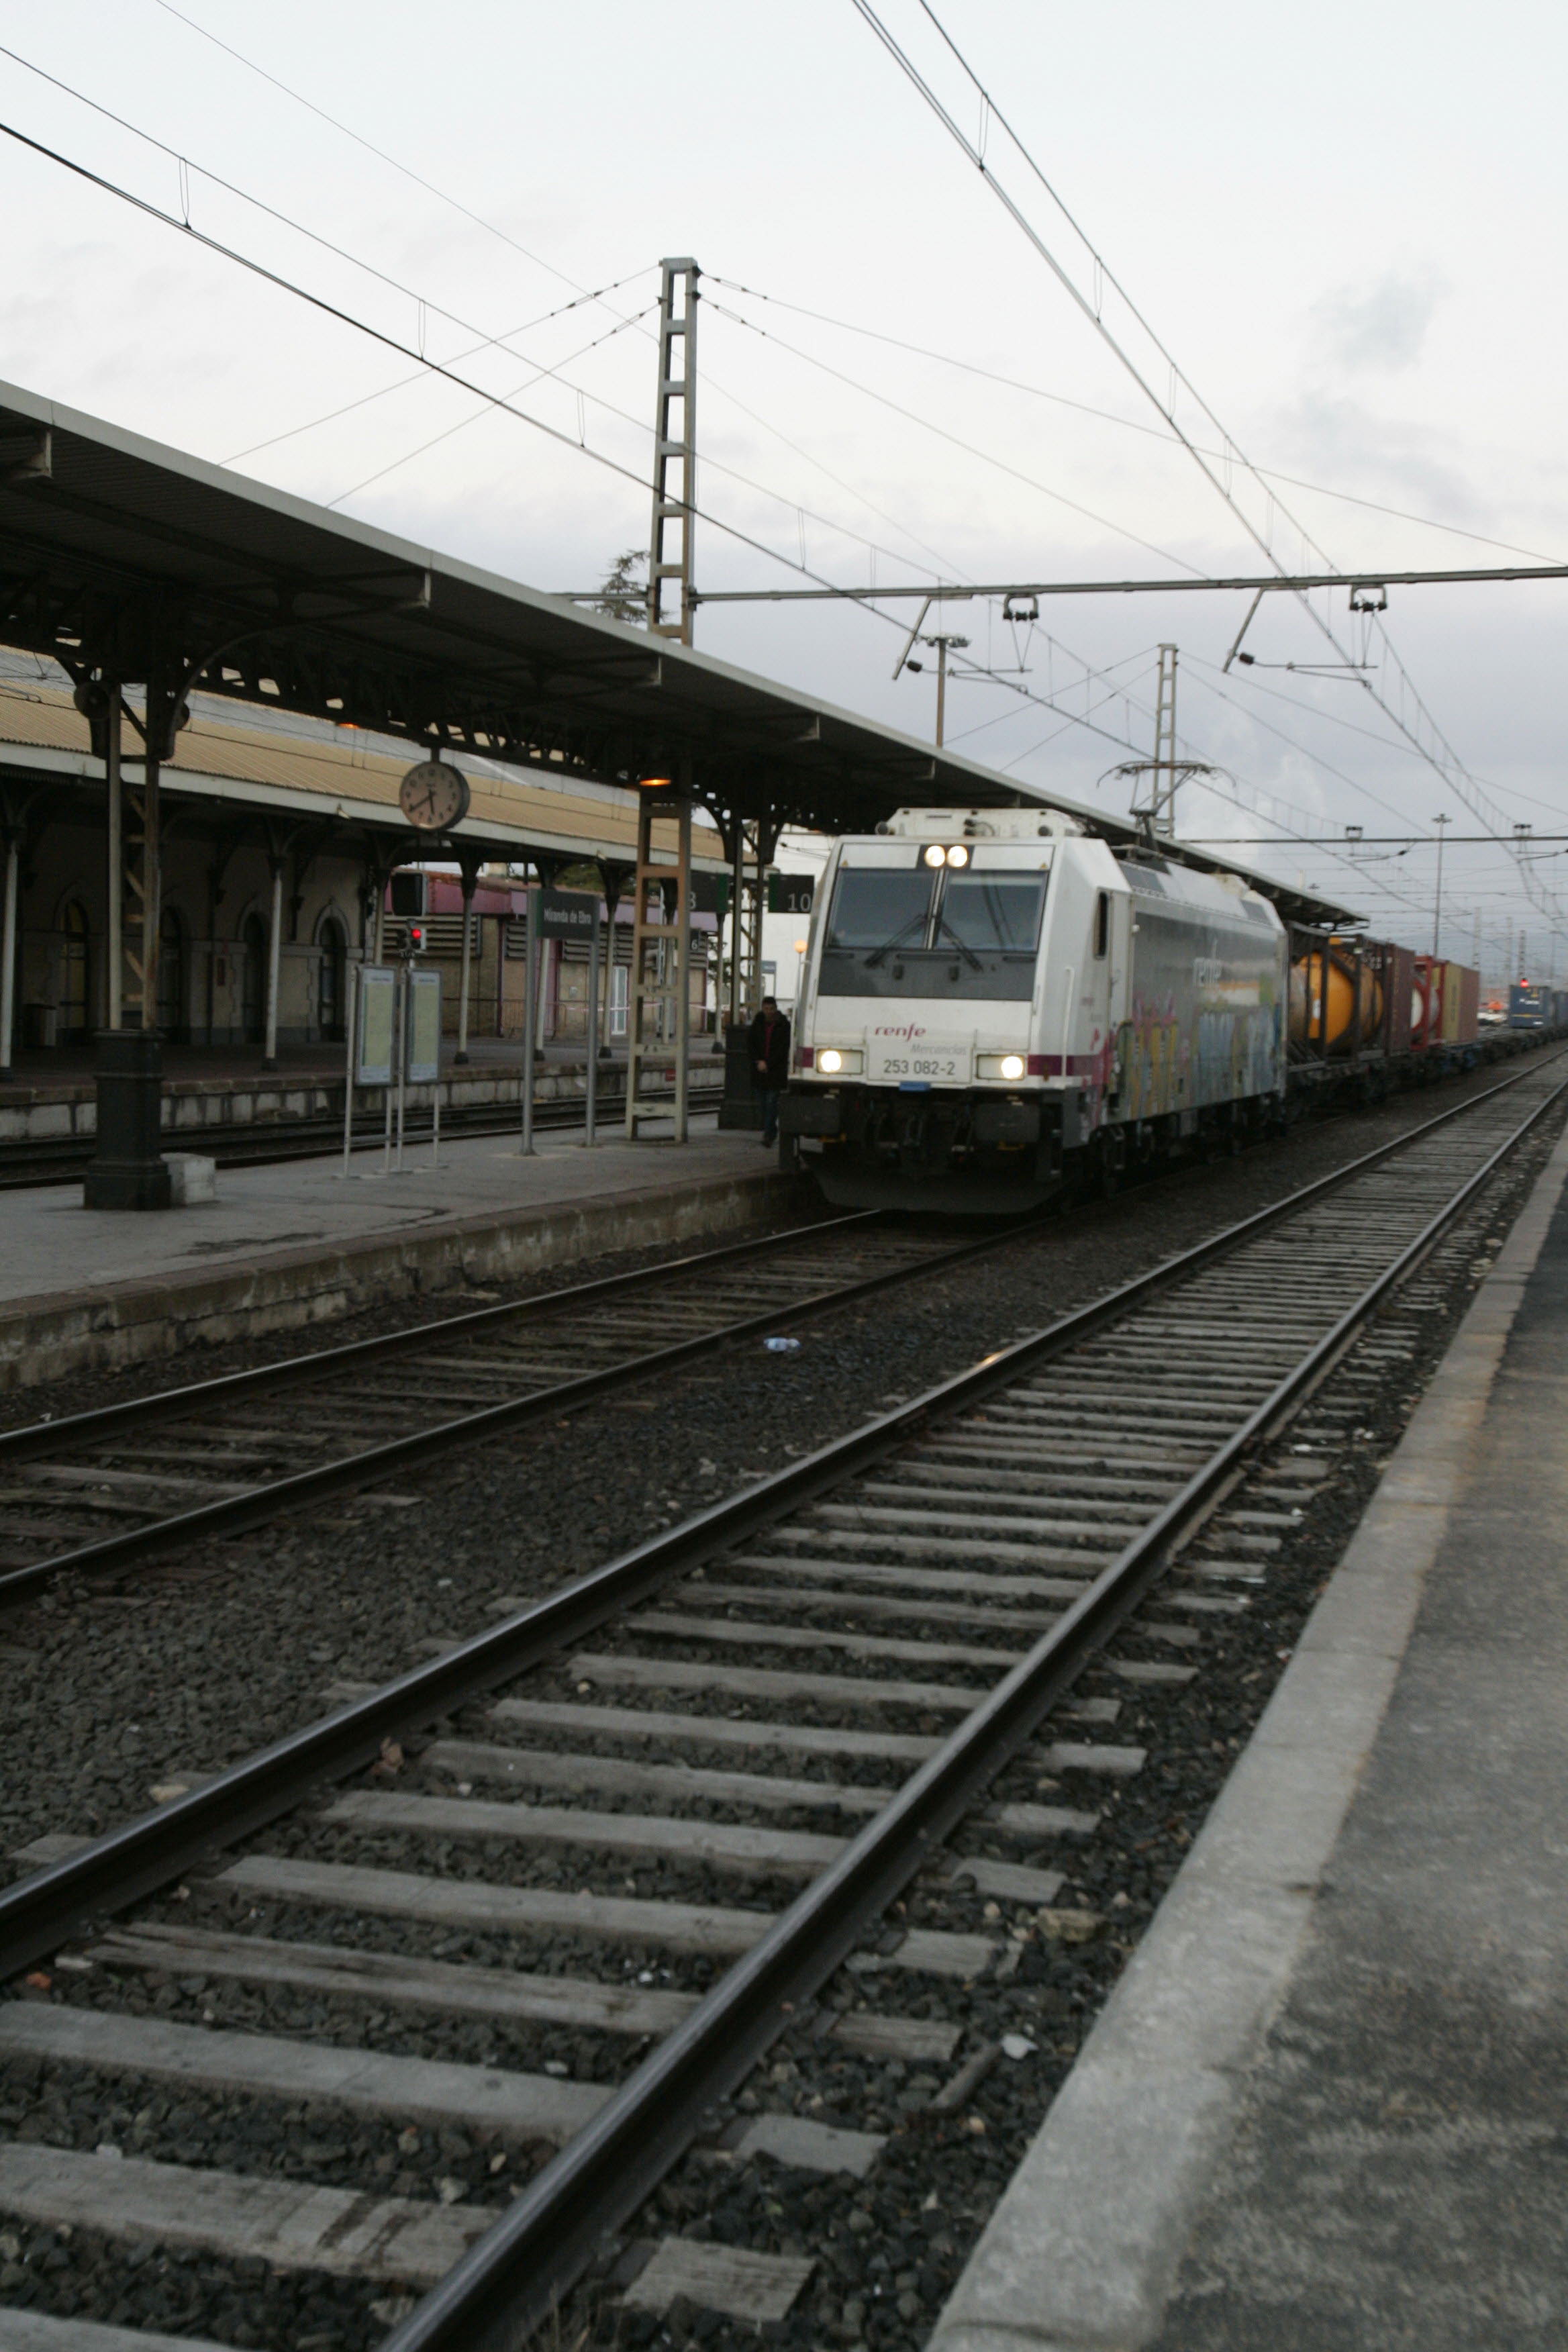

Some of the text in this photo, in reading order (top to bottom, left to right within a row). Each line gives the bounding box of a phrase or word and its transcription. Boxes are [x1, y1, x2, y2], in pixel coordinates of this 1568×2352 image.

[787, 893, 812, 912] 10
[544, 907, 591, 925] Miranda de Ebro
[875, 1022, 926, 1042] renfe
[883, 1059, 956, 1076] 253 082-2
